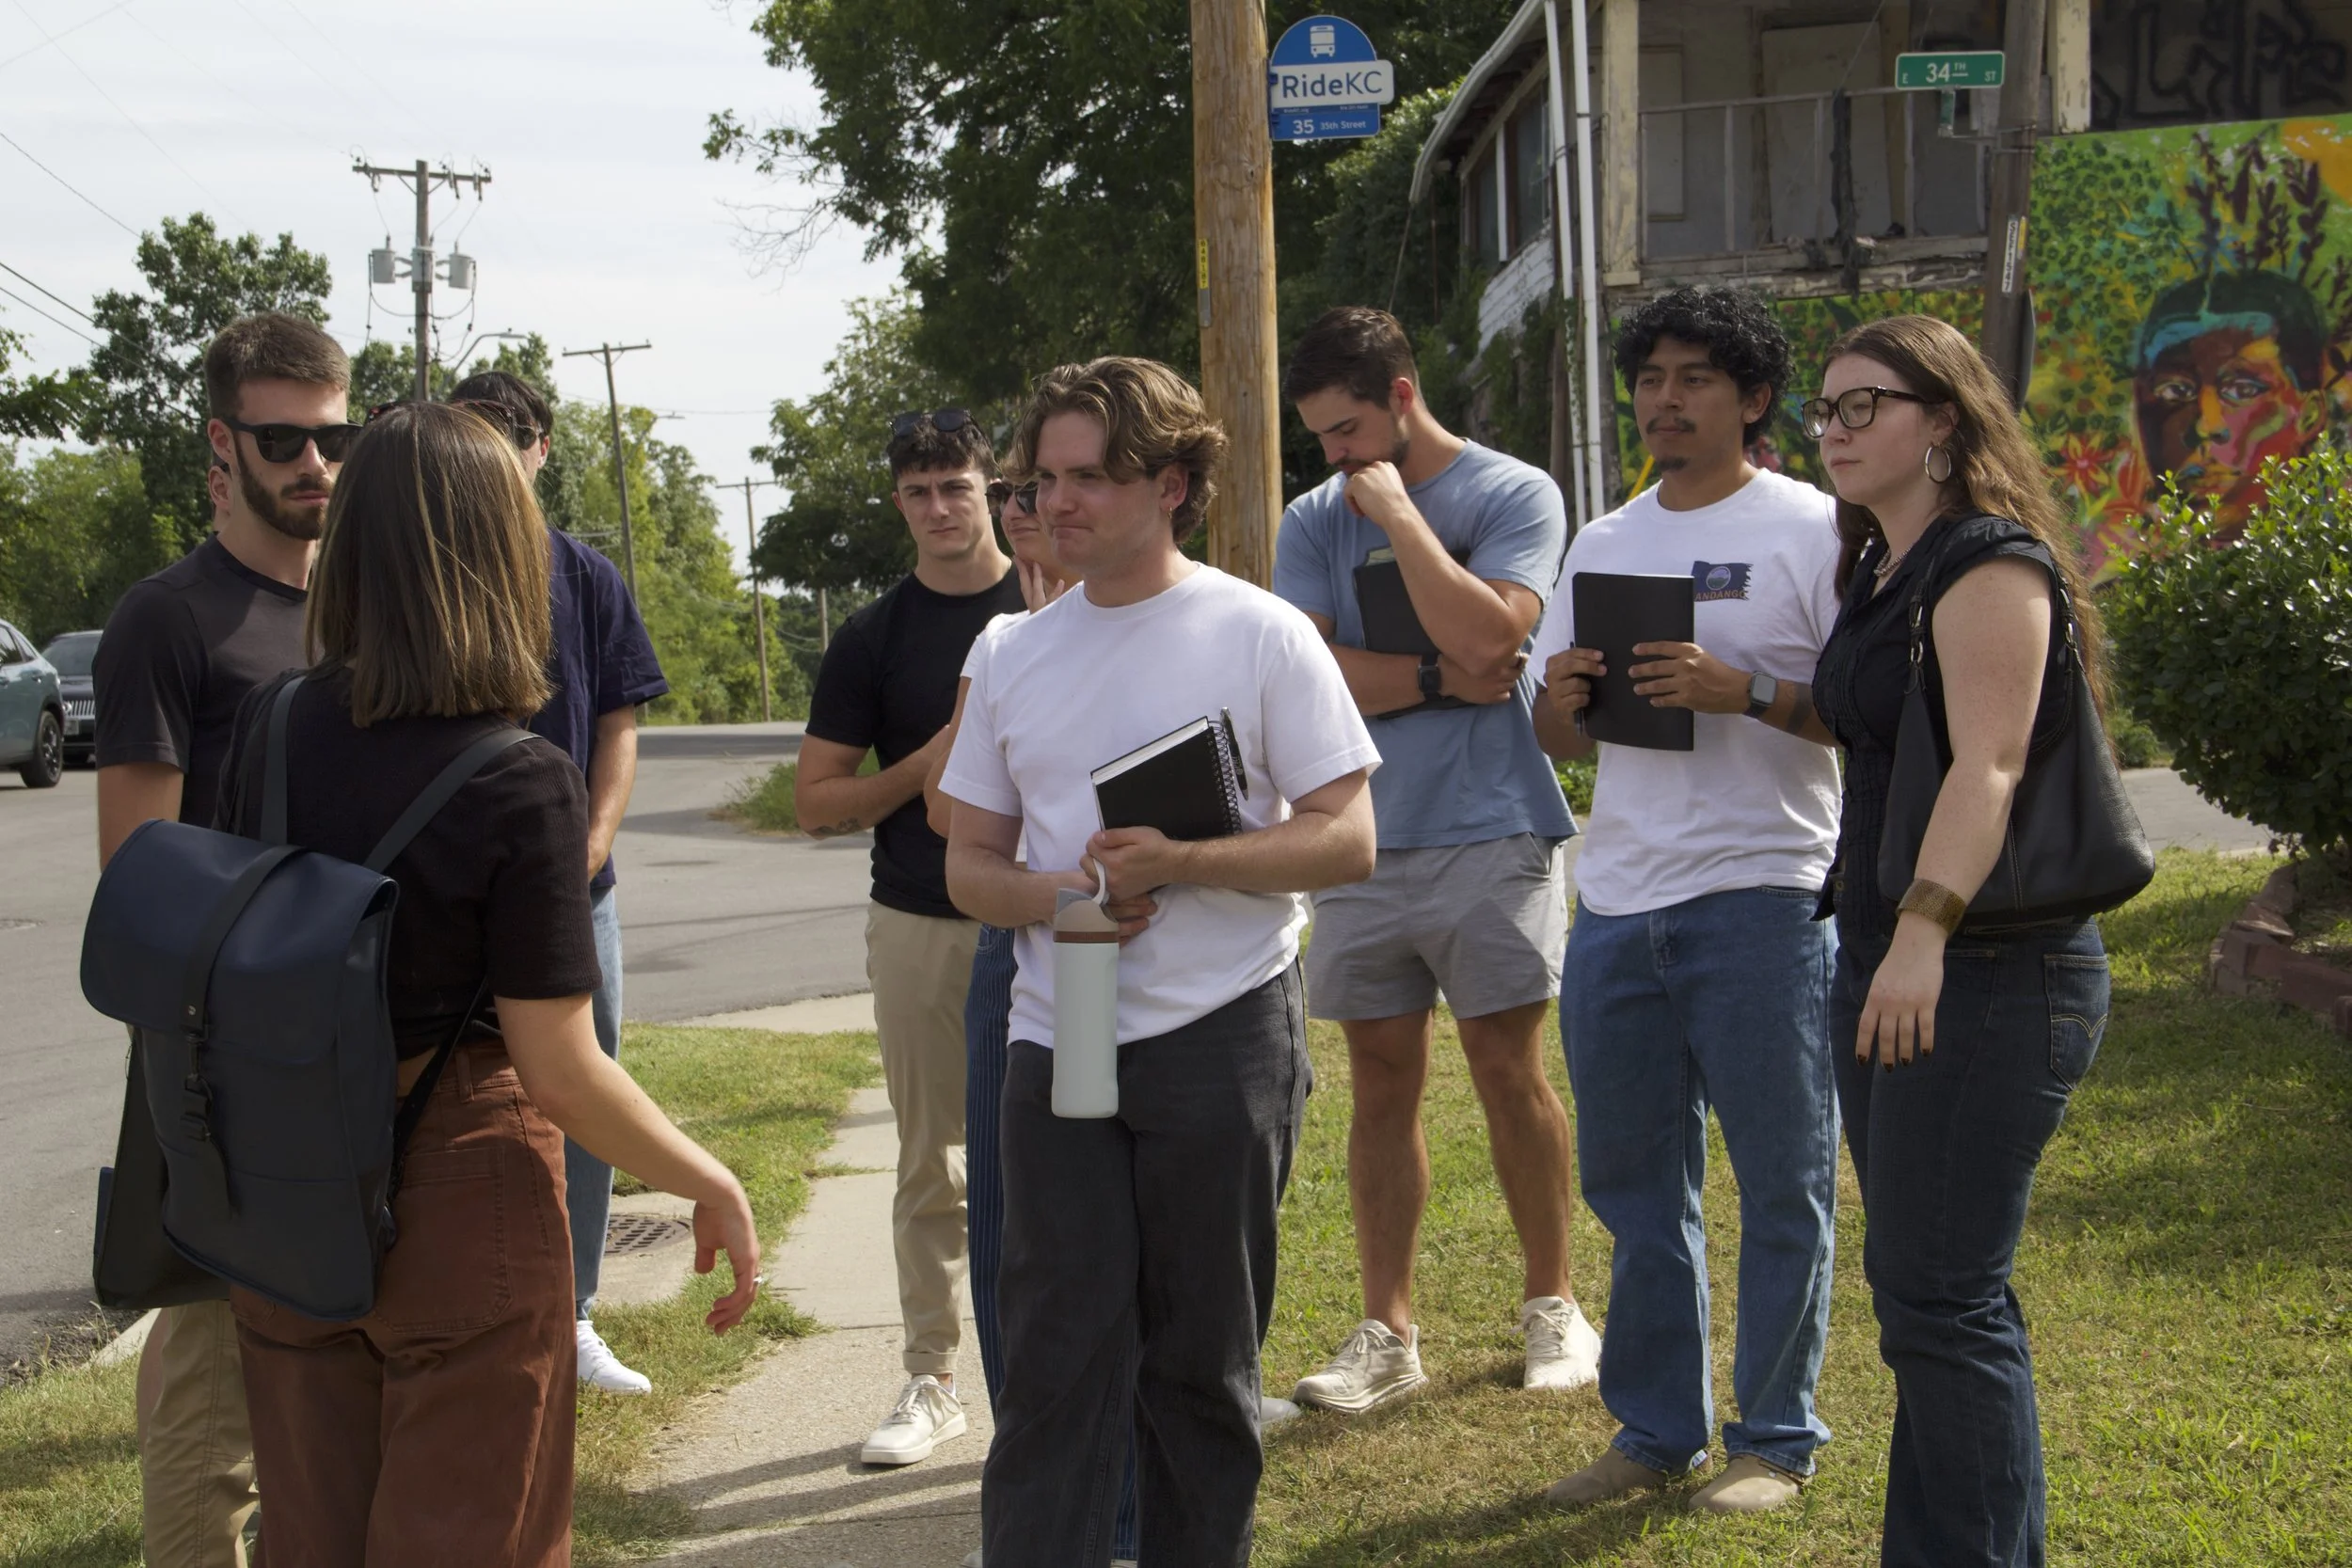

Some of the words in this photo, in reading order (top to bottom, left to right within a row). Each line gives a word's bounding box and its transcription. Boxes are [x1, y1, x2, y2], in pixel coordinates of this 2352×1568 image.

[1282, 71, 1382, 98] RideKC
[1902, 72, 1908, 84] E
[1984, 71, 1996, 82] ST
[1293, 119, 1314, 135] 35
[1320, 121, 1338, 131] 35th
[1341, 120, 1366, 130] Street
[1694, 590, 1747, 601] ANDANGO
